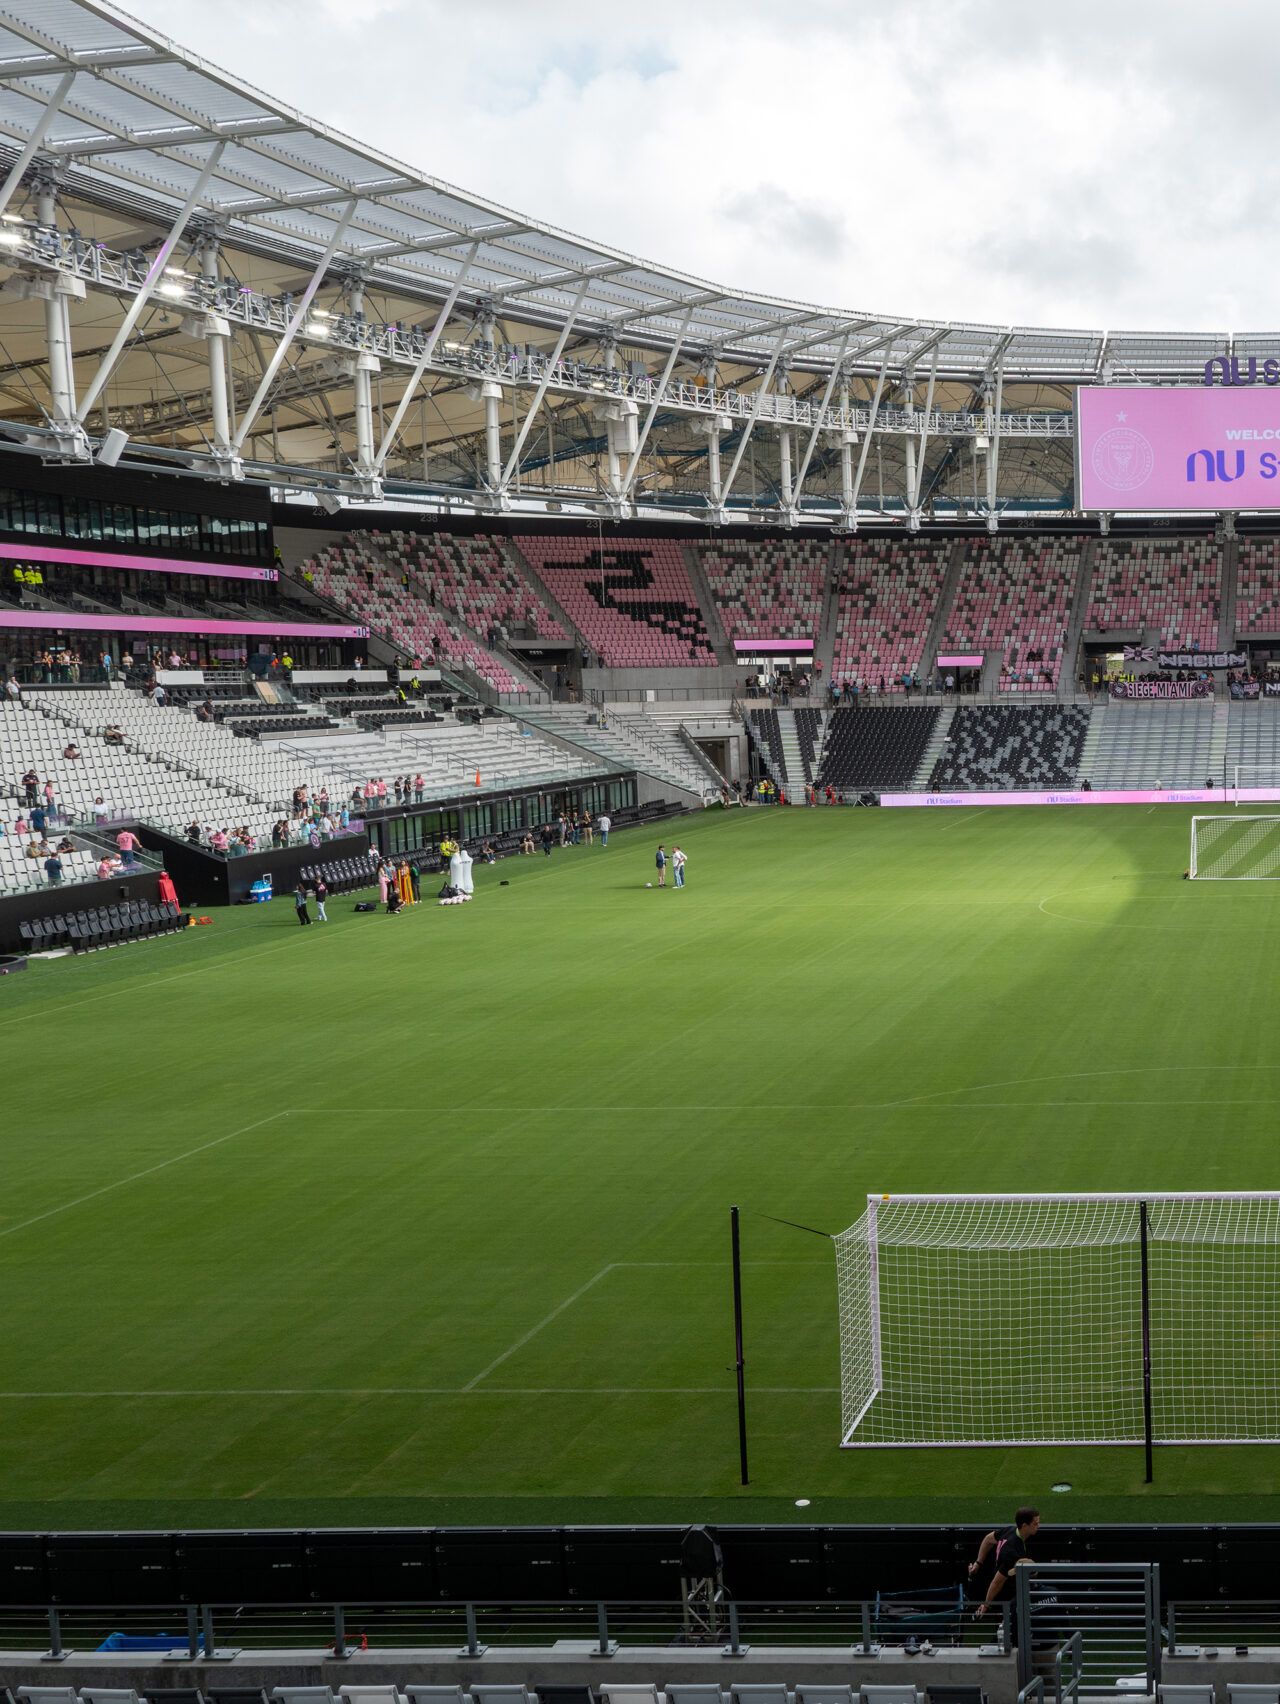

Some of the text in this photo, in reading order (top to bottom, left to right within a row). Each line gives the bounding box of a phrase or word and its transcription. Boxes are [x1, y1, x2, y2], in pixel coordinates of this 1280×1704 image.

[420, 514, 439, 523] 238
[1018, 520, 1035, 528] 234
[1127, 682, 1192, 697] SIEGE MIAMI
